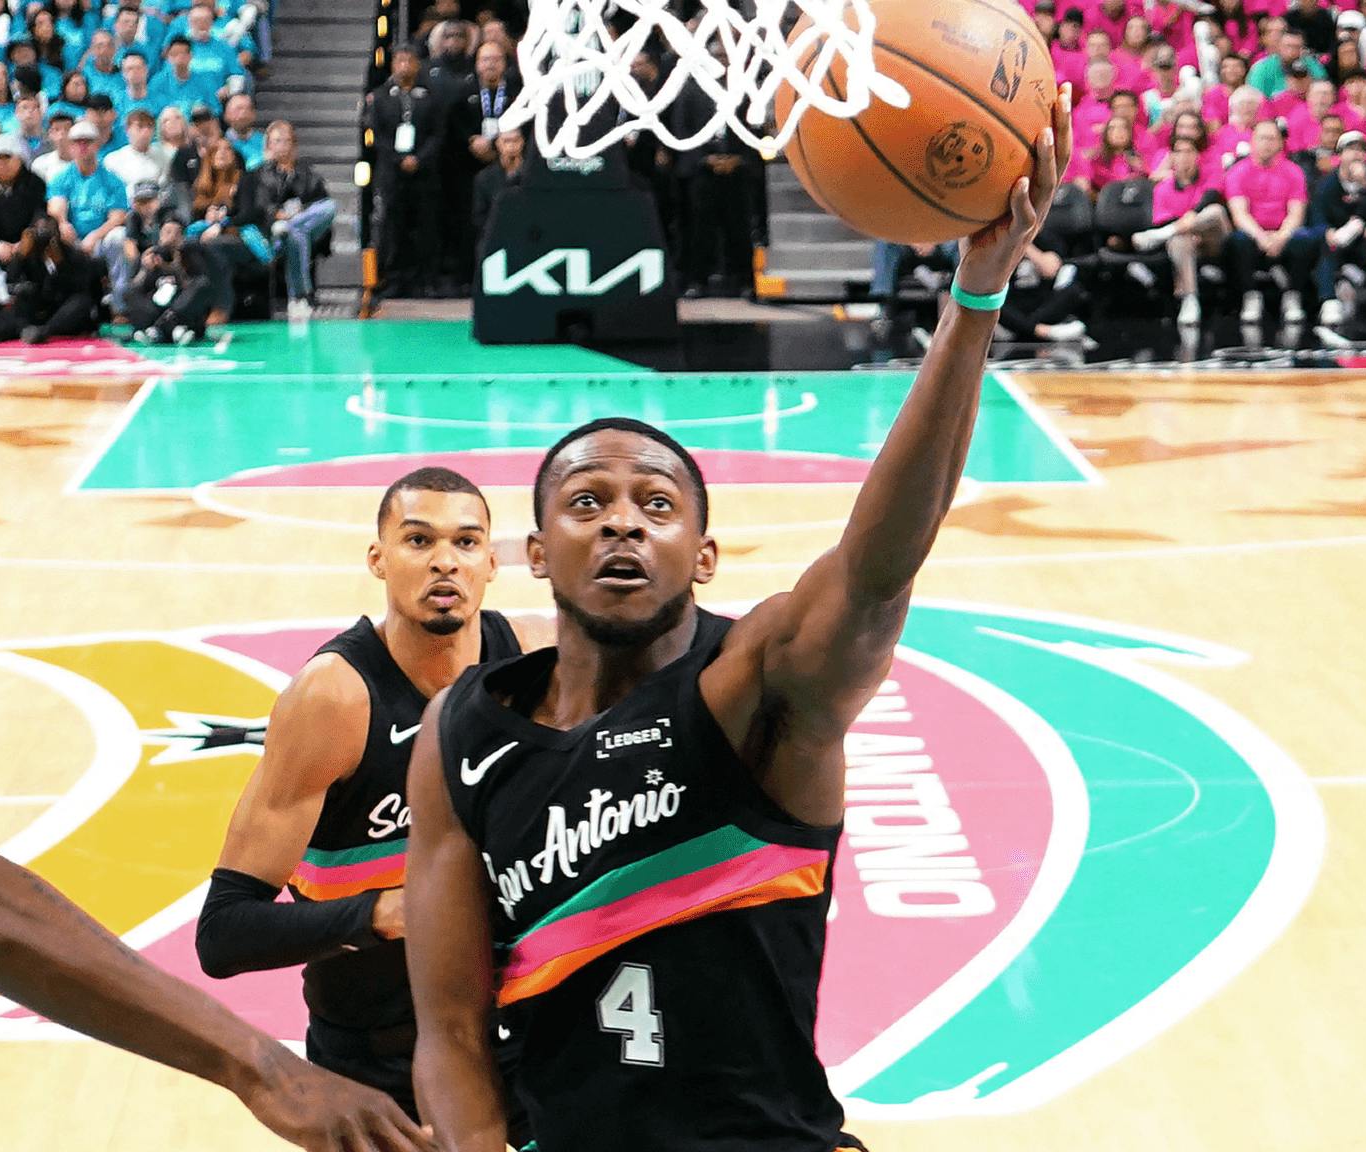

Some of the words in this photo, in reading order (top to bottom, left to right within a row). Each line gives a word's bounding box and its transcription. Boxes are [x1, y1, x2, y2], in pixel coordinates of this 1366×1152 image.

[482, 248, 665, 296] KIA
[605, 727, 662, 750] LEDGER
[368, 792, 412, 839] Sa
[530, 770, 687, 884] Antonio
[843, 732, 996, 918] ANTONIO
[595, 962, 665, 1068] 4
